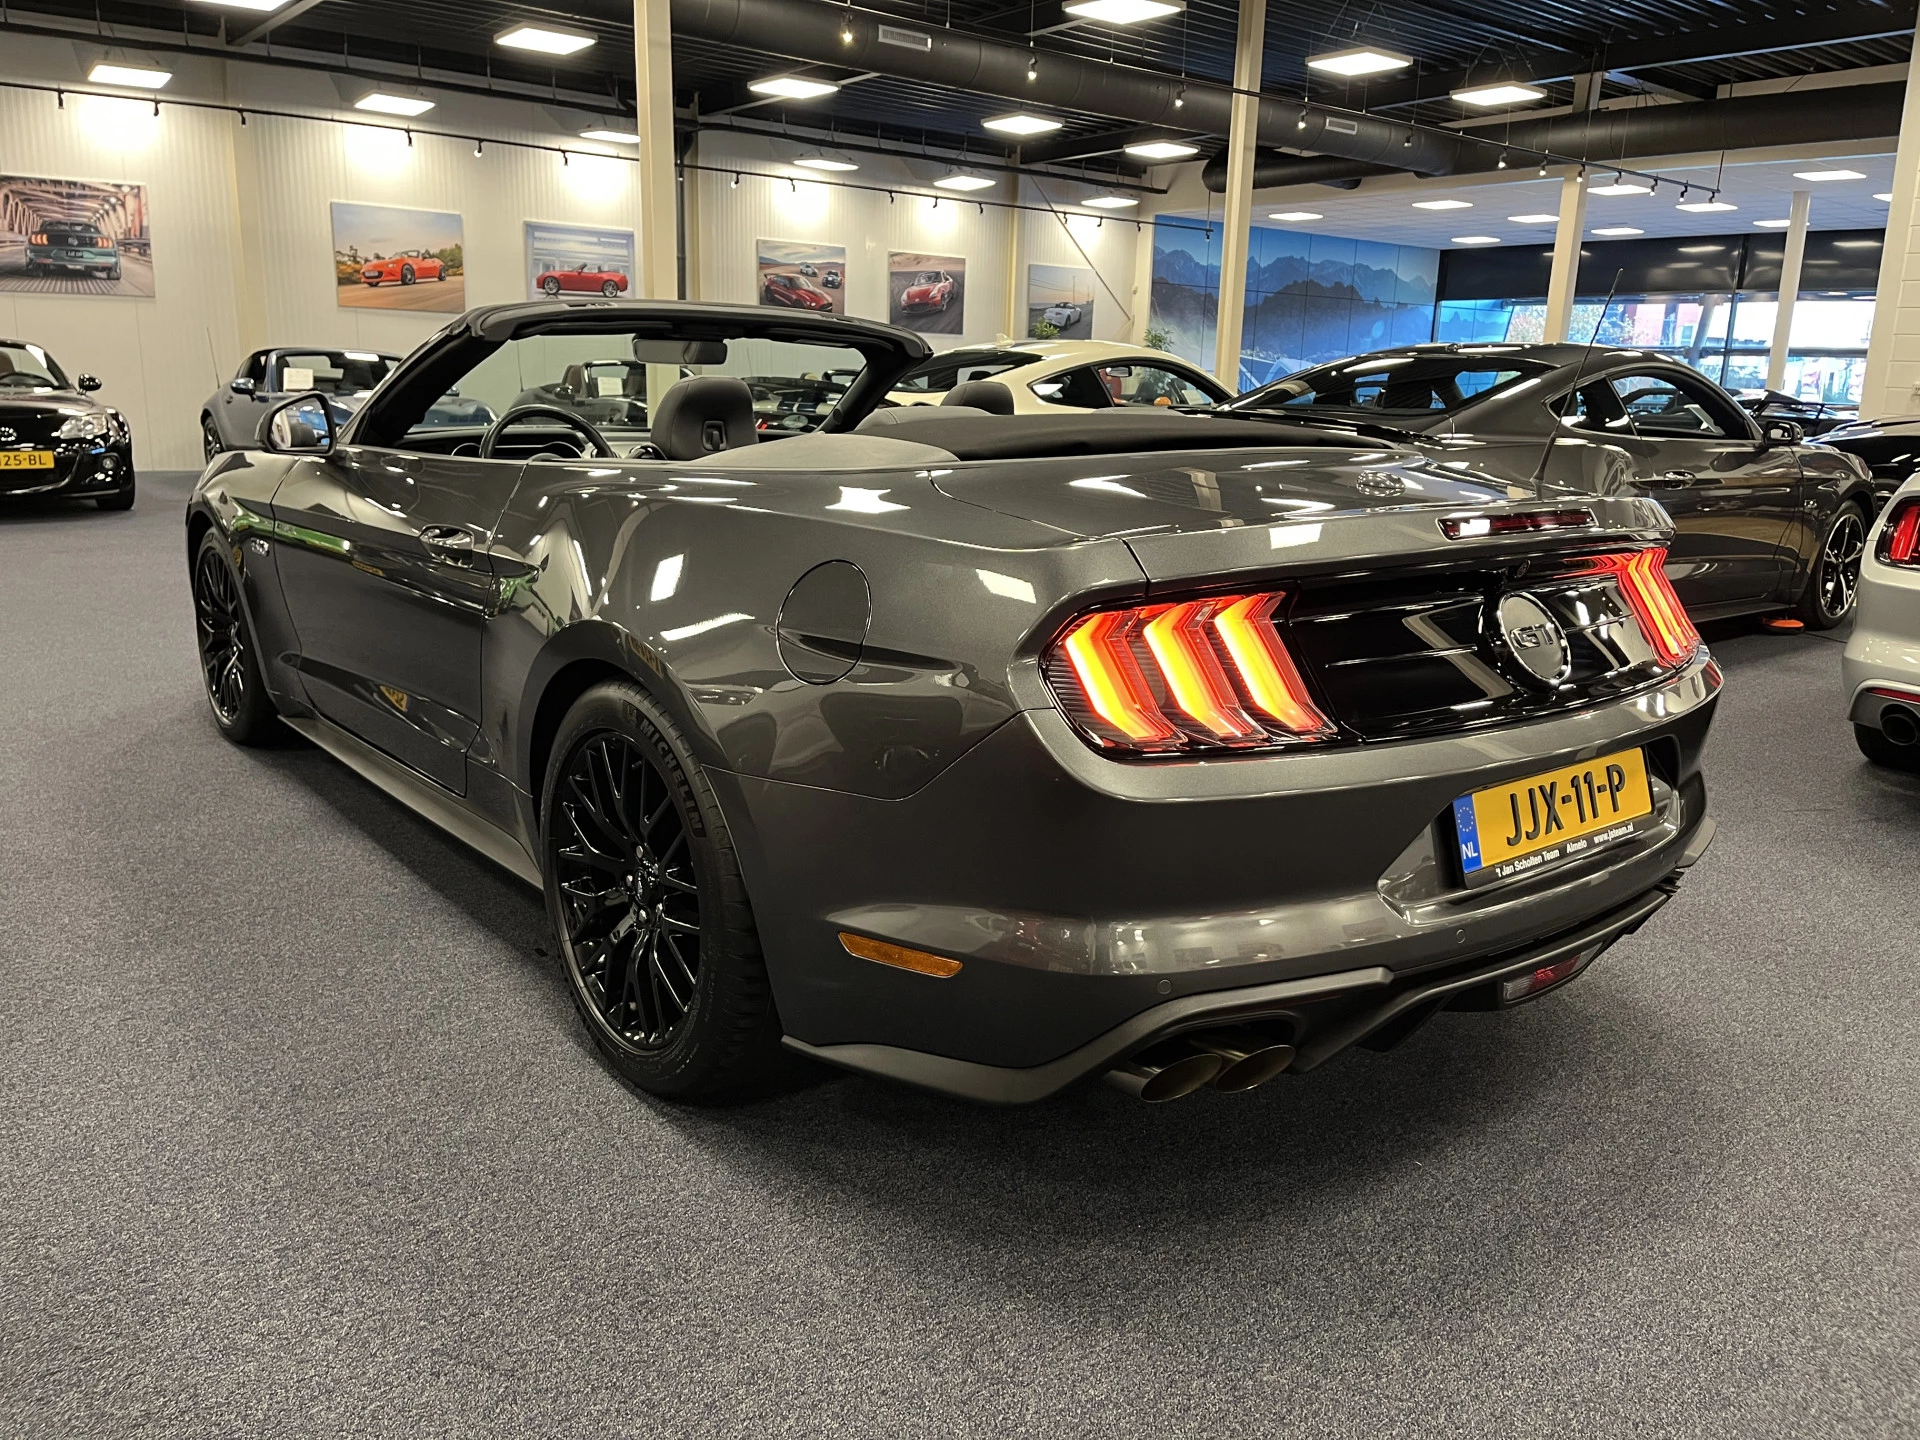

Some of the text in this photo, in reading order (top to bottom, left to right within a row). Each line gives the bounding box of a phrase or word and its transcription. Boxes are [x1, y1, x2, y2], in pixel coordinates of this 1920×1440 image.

[0, 454, 47, 466] 25-BL
[1510, 624, 1554, 649] GT
[639, 720, 703, 830] MICHELIN
[1507, 764, 1625, 846] JJX-11-P
[1461, 842, 1479, 860] NL
[1502, 864, 1514, 876] Jan
[1514, 856, 1542, 870] Scholten
[1542, 849, 1559, 861] Team
[1566, 838, 1588, 854] Almelo
[1593, 823, 1633, 842] www.jsteam.nl
